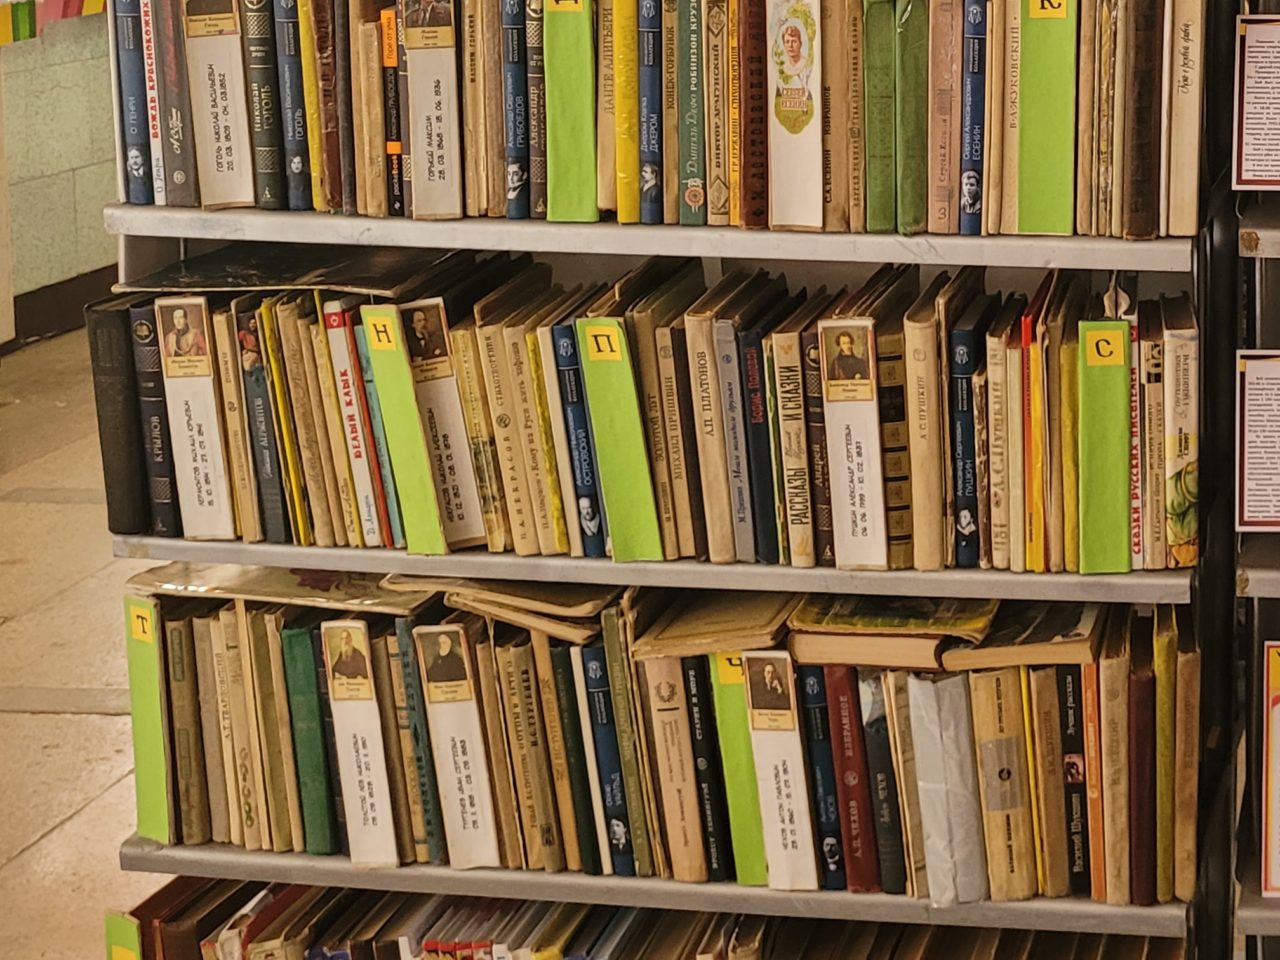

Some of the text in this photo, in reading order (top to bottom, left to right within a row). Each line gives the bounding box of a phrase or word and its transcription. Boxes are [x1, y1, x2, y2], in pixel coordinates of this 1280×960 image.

[141, 0, 156, 92] КРАСНОКОЖИХ
[386, 16, 394, 32] ума
[386, 41, 394, 60] Горе
[601, 7, 614, 116] ДАНТЕ АЛИГЬЕРИ
[689, 34, 698, 92] РОБИНЗОН
[251, 82, 262, 133] Николай
[260, 84, 274, 130] ГОГОЛЬ
[294, 108, 304, 140] ГОГОЛЬ
[514, 95, 524, 148] ГРИБОЕДОВ
[528, 85, 539, 148] Александр
[712, 44, 722, 170] ВИКТОР ДРАГУНСКИЙ
[425, 114, 436, 182] ГОРЬКИЙ МАКСИМ
[648, 113, 659, 152] ДЖЕРОМ
[972, 125, 982, 160] ЕСЕНИН
[215, 145, 225, 172] ГОГОЛЬ
[373, 323, 392, 344] Н
[591, 333, 616, 354] П
[1094, 339, 1114, 359] С
[696, 350, 712, 413] ПЛАТОНОВ
[340, 368, 363, 460] БЕЛЫЙ КЛЫК
[664, 375, 684, 481] МИХАИЛ ПРИШВИН
[751, 392, 764, 424] Борис
[150, 416, 164, 462] КРЫЛОВ
[578, 428, 593, 486] ОСТРОВСКИЙ
[780, 364, 810, 526] РАССКАЗЫ И СКАЗКИ
[812, 443, 823, 487] Андрей
[964, 460, 974, 496] ПУШКИН
[136, 616, 150, 636] Т
[840, 694, 859, 836] ЧЕХОВ ИЗБРАННОЕ
[1070, 792, 1082, 833] Шукшин
[1072, 834, 1084, 873] Василий
